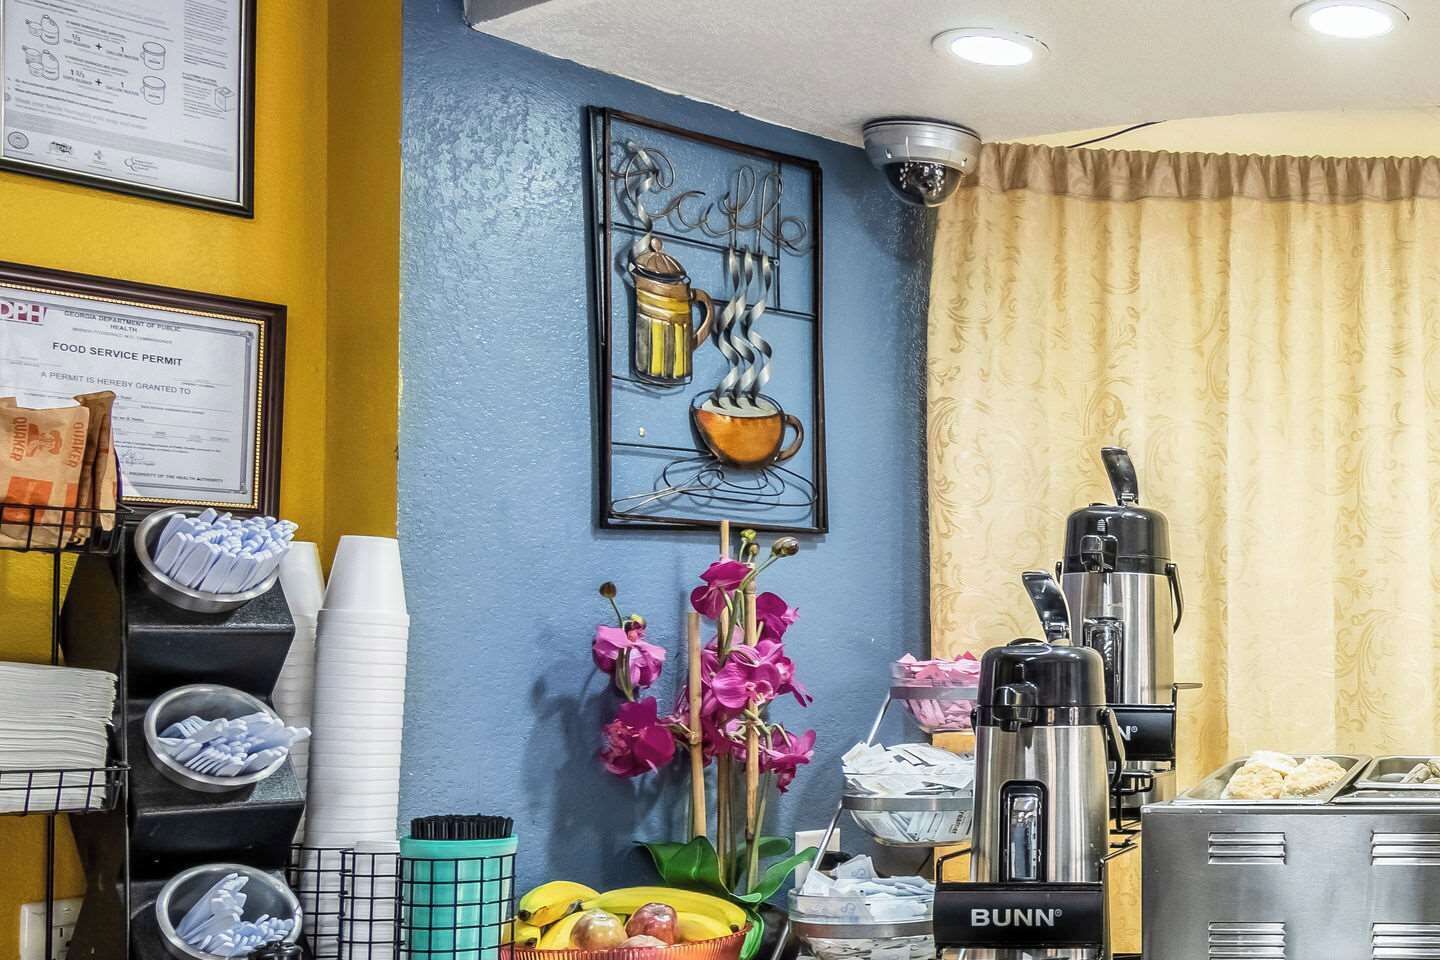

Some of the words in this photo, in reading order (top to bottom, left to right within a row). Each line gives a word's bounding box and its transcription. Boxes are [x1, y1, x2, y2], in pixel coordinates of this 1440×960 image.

[64, 310, 97, 321] GEORGIA
[98, 313, 145, 328] DEPARTMENT
[146, 321, 155, 329] OF
[157, 323, 181, 332] PUBLIC
[110, 324, 138, 333] HEALTH
[52, 342, 87, 354] FOOD
[89, 347, 139, 361] SERVICE
[142, 354, 183, 366] PERMIT
[49, 372, 84, 382] PERMIT
[86, 376, 95, 384] IS
[97, 378, 133, 389] HEREBY
[135, 382, 178, 394] GRANTED
[180, 387, 192, 395] TO
[10, 416, 28, 462] QUAKER
[64, 422, 84, 468] QUAKER
[971, 908, 1055, 927] BUNN
